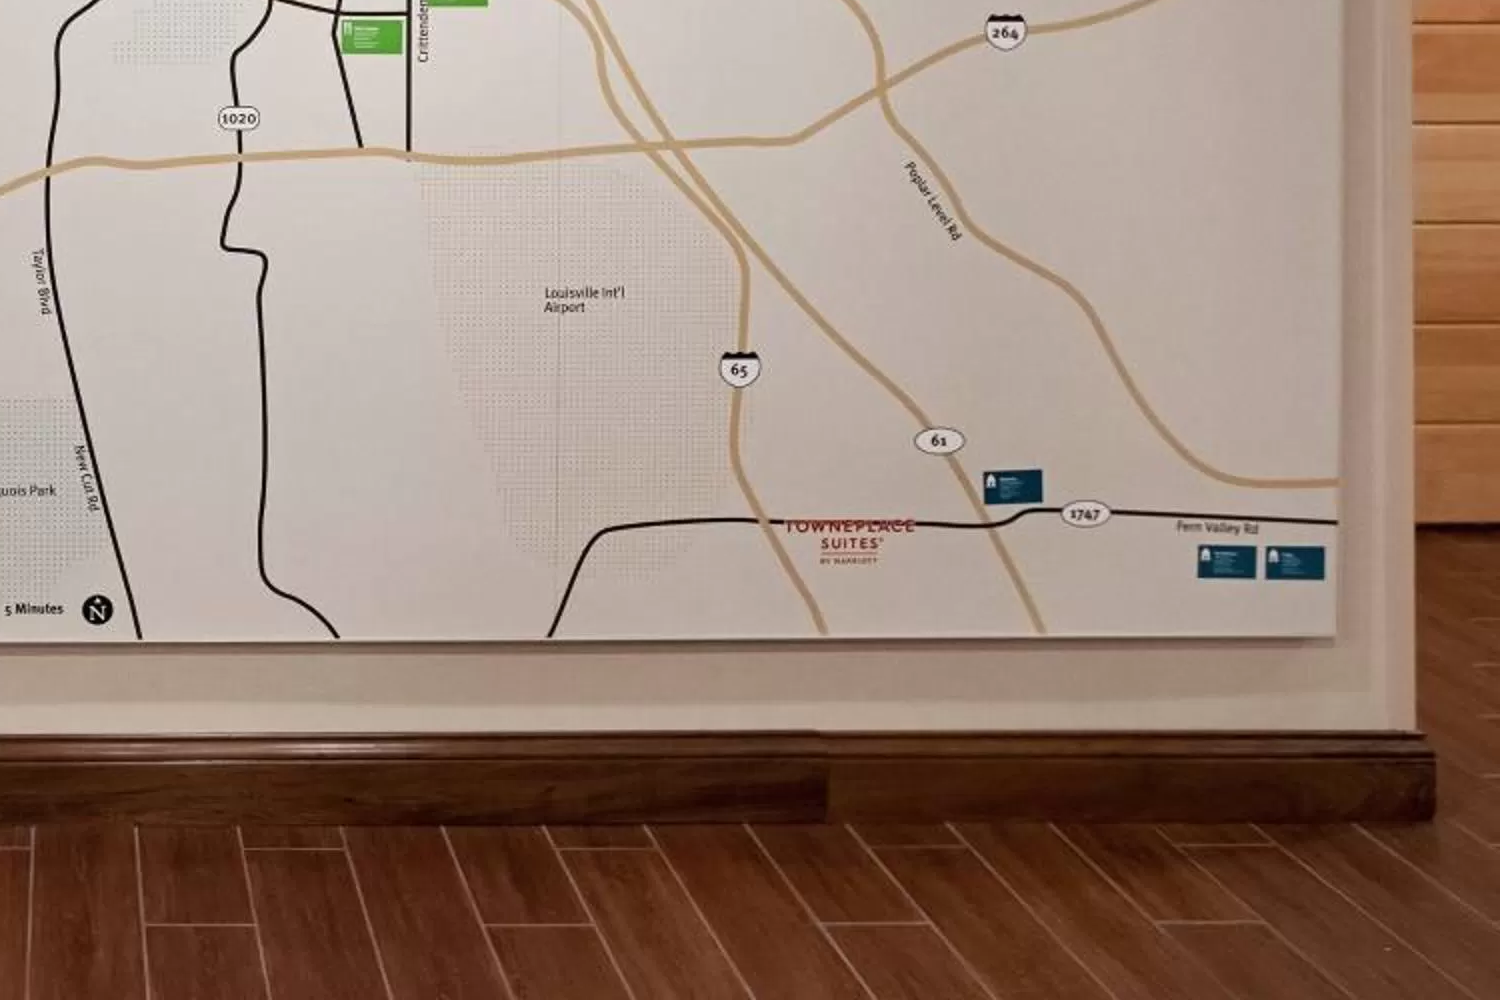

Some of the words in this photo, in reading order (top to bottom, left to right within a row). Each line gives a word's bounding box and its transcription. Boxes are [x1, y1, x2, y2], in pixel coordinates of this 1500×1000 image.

[991, 25, 1019, 40] 264
[221, 113, 257, 125] 1020
[904, 160, 932, 199] Poplar
[926, 196, 954, 228] Level
[946, 222, 963, 242] Rd
[31, 247, 47, 286] Taylor
[544, 286, 600, 299] Louisville
[601, 285, 626, 299] Int'l
[37, 286, 53, 316] Blvd
[543, 301, 586, 315] Airport
[730, 362, 749, 379] 65
[931, 433, 947, 448] 61
[74, 444, 88, 472] New
[29, 485, 58, 497] Park
[80, 472, 97, 495] Cut
[87, 493, 101, 513] Rd
[1069, 508, 1102, 522] 1747
[784, 519, 917, 534] TOWNEPLACE
[1176, 520, 1203, 533] Fern
[1204, 521, 1241, 537] Valley
[1243, 523, 1260, 536] Rd
[4, 604, 13, 617] 5
[15, 603, 65, 615] Minutes
